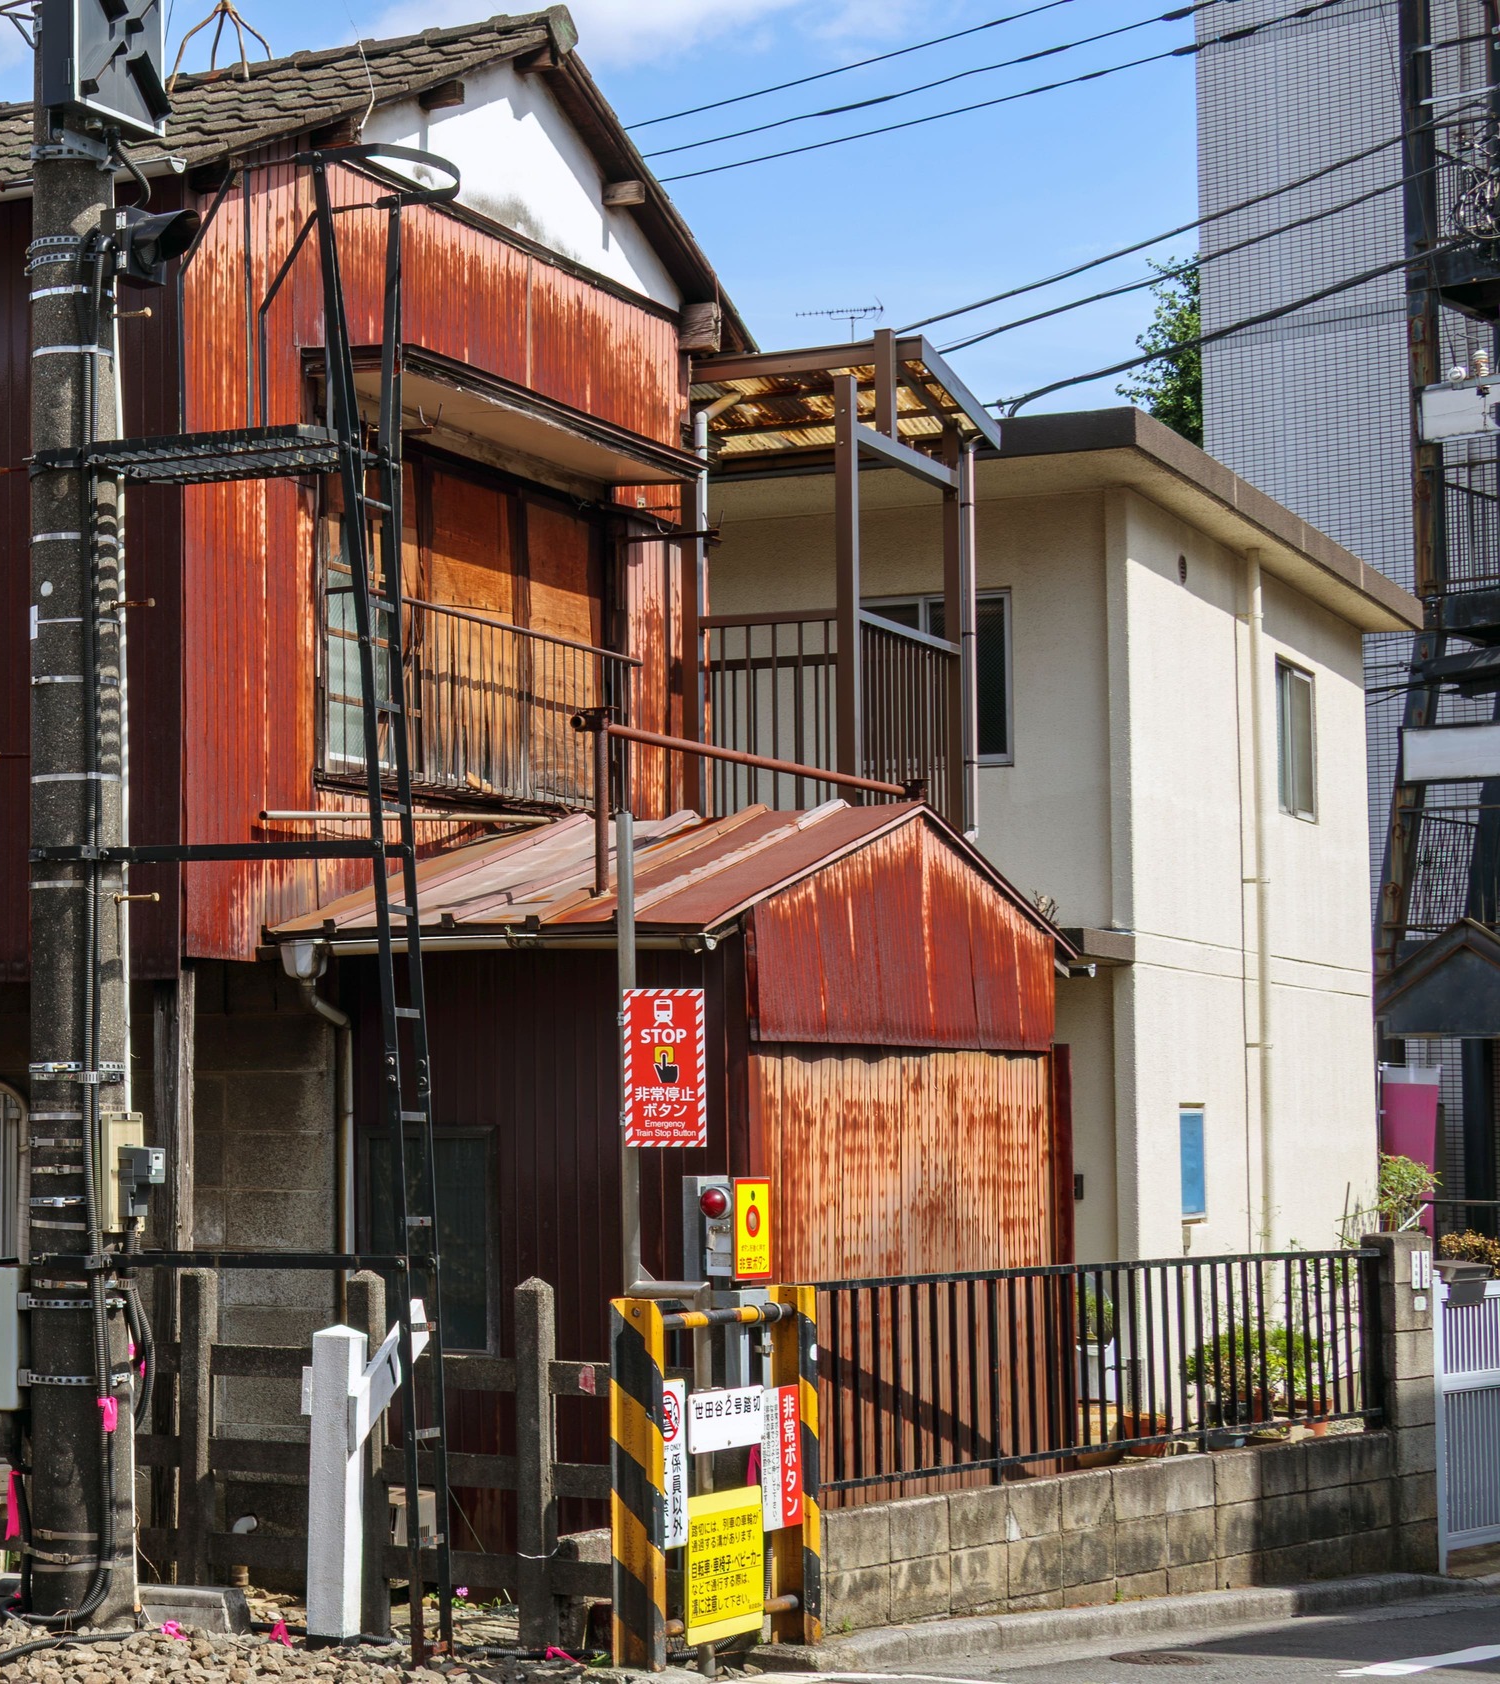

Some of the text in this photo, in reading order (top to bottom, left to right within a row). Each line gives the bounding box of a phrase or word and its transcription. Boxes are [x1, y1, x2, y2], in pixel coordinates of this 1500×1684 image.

[640, 1028, 687, 1044] STOP
[634, 1086, 695, 1102] 非常停止
[643, 1103, 688, 1118] ボタン
[644, 1120, 686, 1130] Emergency
[635, 1129, 697, 1138] Train Stop Button
[695, 1395, 760, 1420] 世田谷2号踏切
[782, 1395, 799, 1517] 非常ボタン
[671, 1453, 683, 1538] 係員以外
